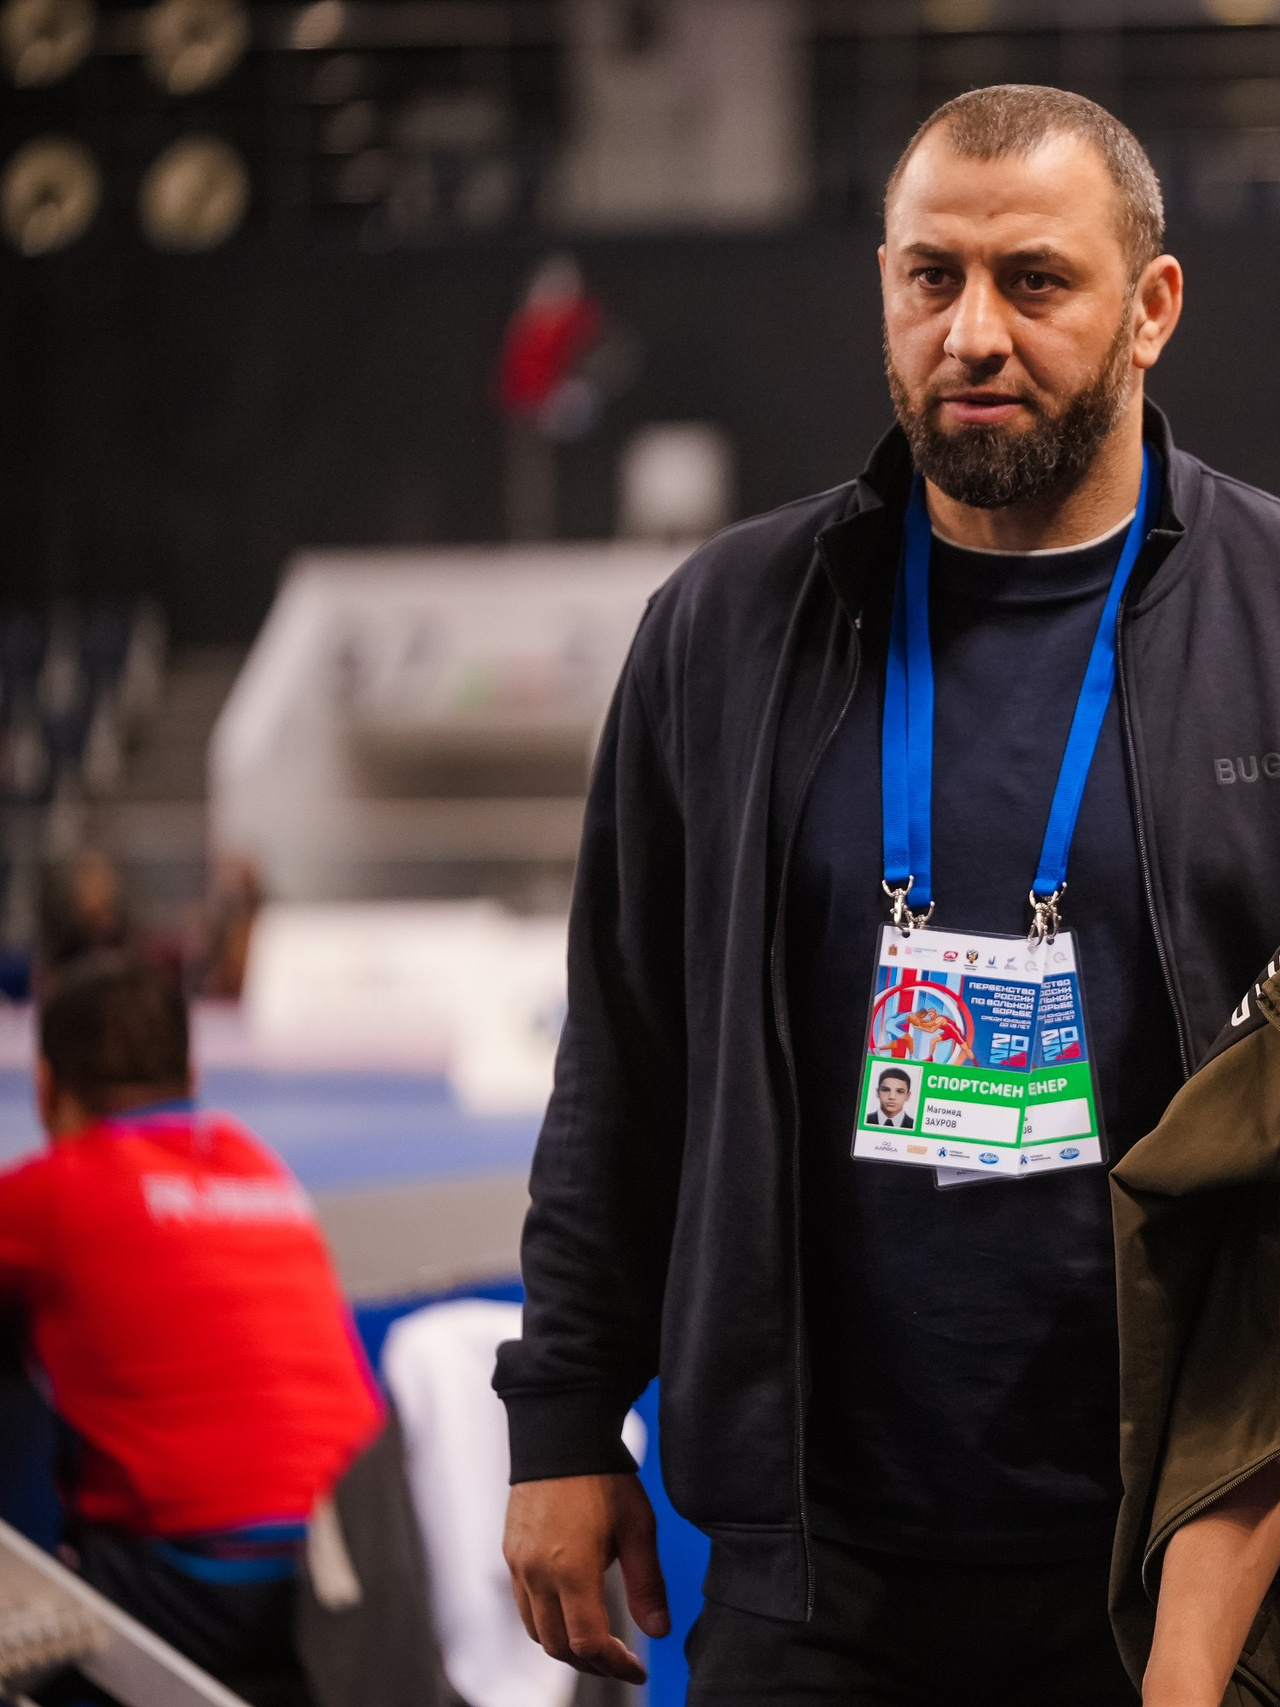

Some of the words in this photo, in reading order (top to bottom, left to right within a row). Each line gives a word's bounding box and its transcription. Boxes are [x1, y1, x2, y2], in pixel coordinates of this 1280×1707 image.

[969, 982, 1036, 996] ПЕРВЕНСТВО
[994, 992, 1035, 1003] РОССИИ
[971, 997, 985, 1005] ПО
[986, 999, 1034, 1011] ВОЛЬНОЙ
[992, 1007, 1032, 1018] БОРЬБЕ
[927, 1075, 1024, 1098] СПОРТСМЕН
[926, 1105, 962, 1117] Магомед
[925, 1117, 957, 1128] ЗАУРОВ
